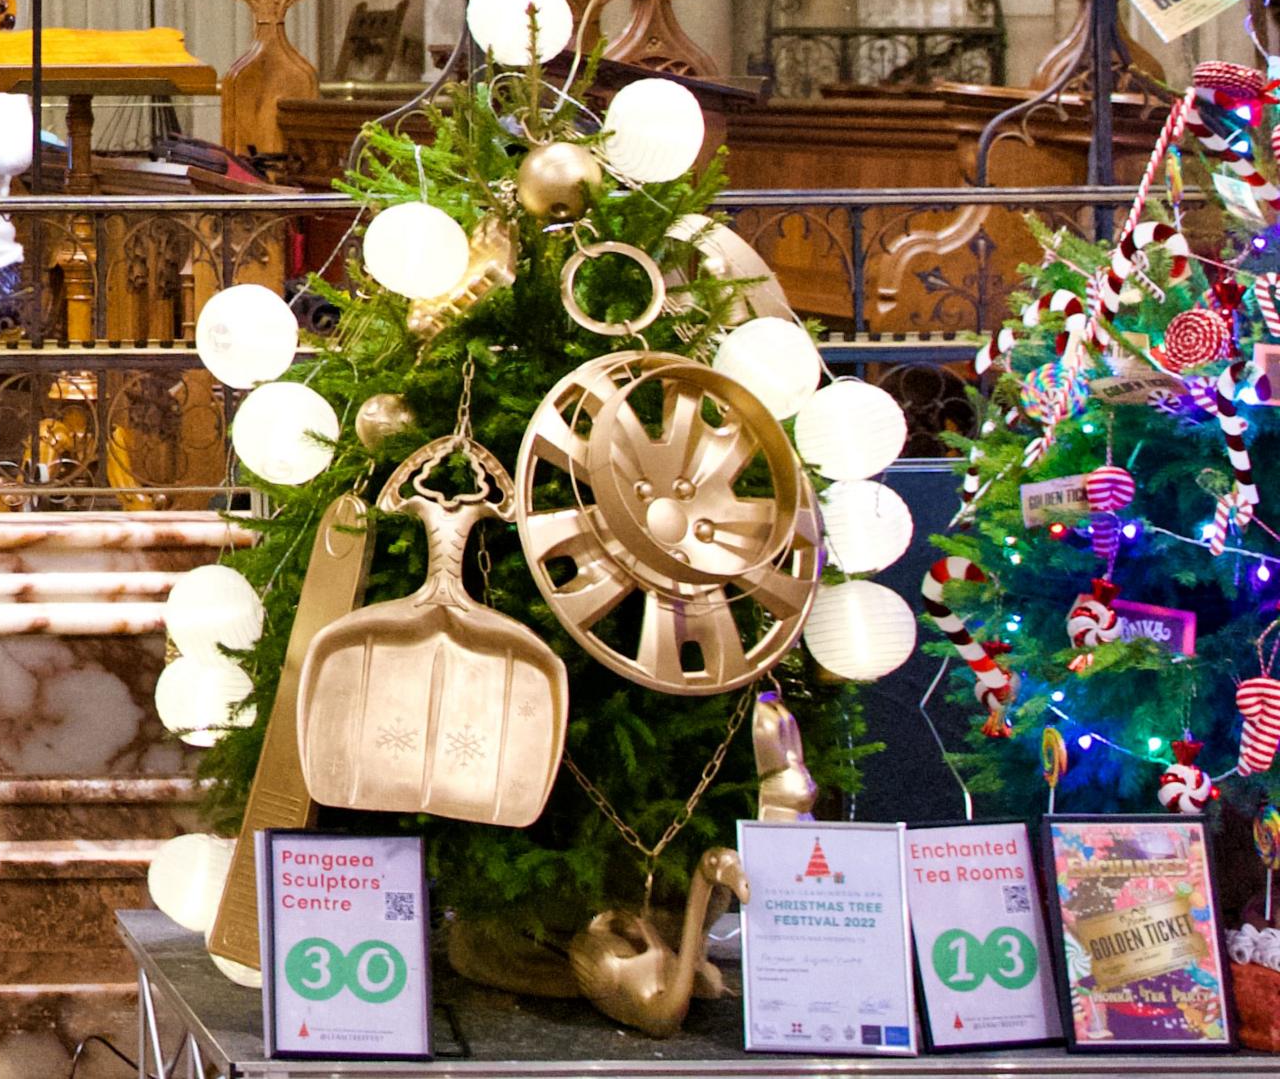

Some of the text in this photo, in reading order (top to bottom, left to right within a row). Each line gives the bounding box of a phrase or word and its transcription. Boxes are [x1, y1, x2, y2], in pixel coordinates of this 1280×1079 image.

[1119, 617, 1172, 643] ONKA
[911, 840, 1017, 859] Enchanted
[282, 850, 375, 871] Pangaea
[914, 865, 1025, 884] Tea Rooms
[282, 894, 353, 912] Centre
[765, 899, 884, 914] CHRISTMAS TREE
[774, 914, 877, 929] FESTIVAL 2022
[1090, 927, 1144, 961] GOLDEN
[1144, 914, 1193, 945] TICKET
[948, 934, 1026, 983] 13
[301, 945, 396, 994] 30
